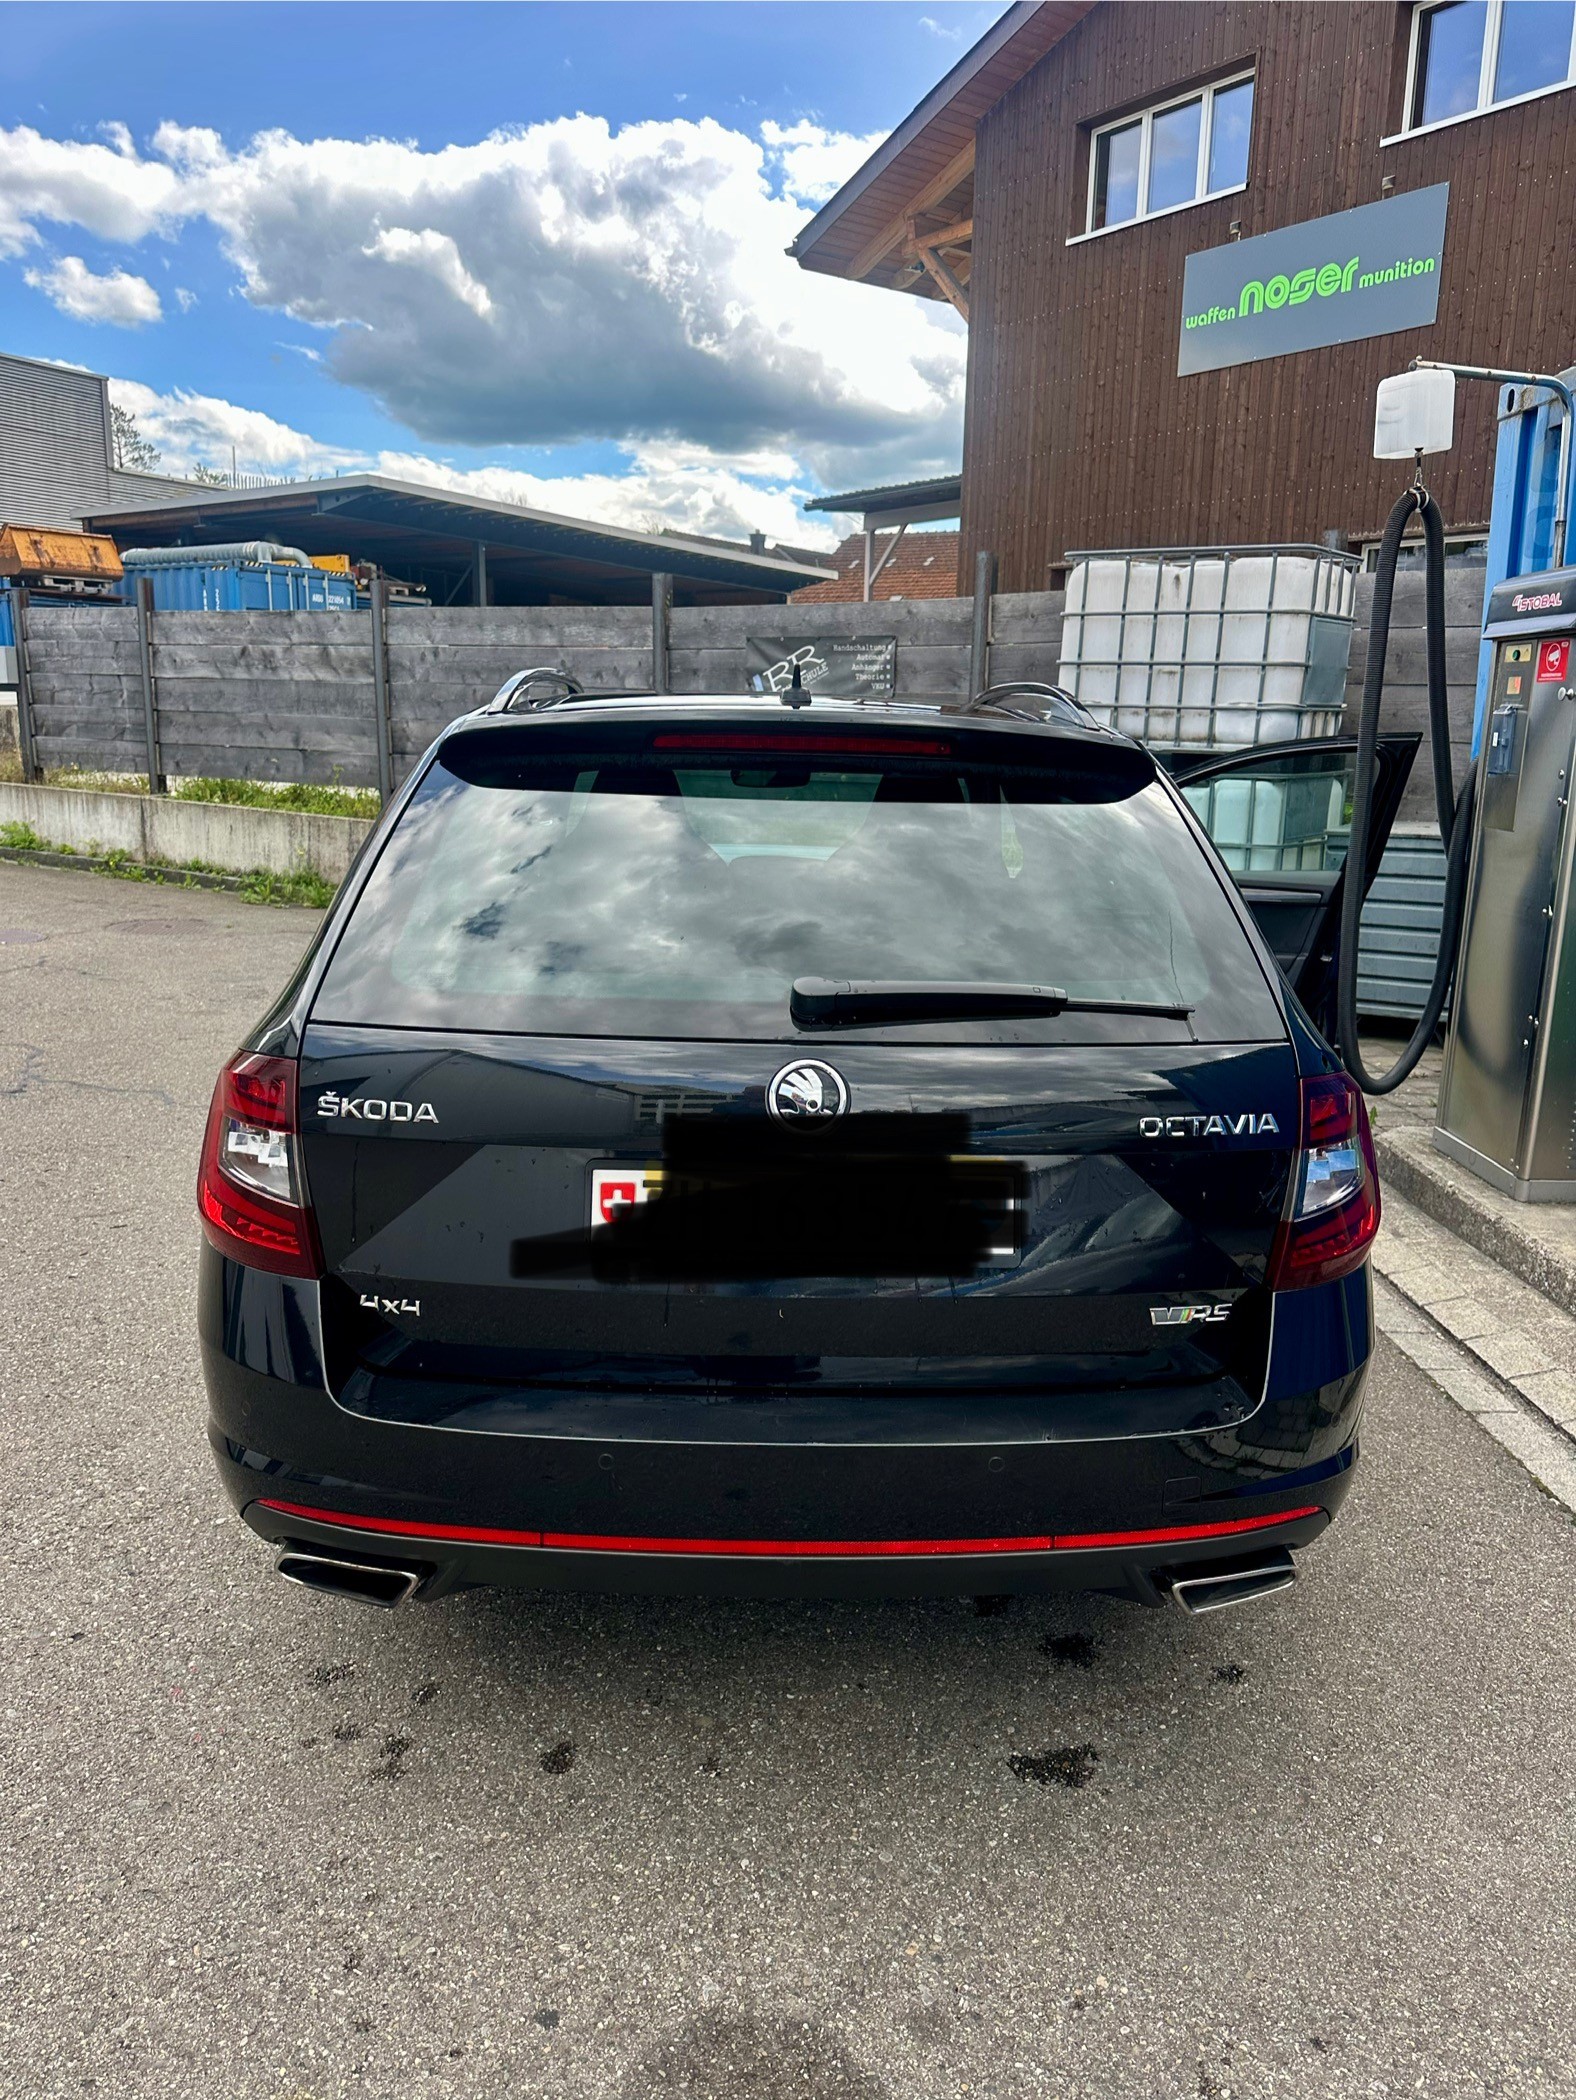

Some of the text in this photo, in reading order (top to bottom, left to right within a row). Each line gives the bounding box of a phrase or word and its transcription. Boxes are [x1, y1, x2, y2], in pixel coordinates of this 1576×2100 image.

[1185, 256, 1435, 330] waffen noser munition
[1512, 592, 1563, 612] ISTOBAL
[832, 644, 887, 653] Handschaltung
[856, 653, 885, 661] Automat
[855, 673, 885, 681] Theorie
[316, 1091, 440, 1124] ŠKODA
[1138, 1113, 1280, 1138] OCTAVIA
[359, 1294, 421, 1316] 4x4
